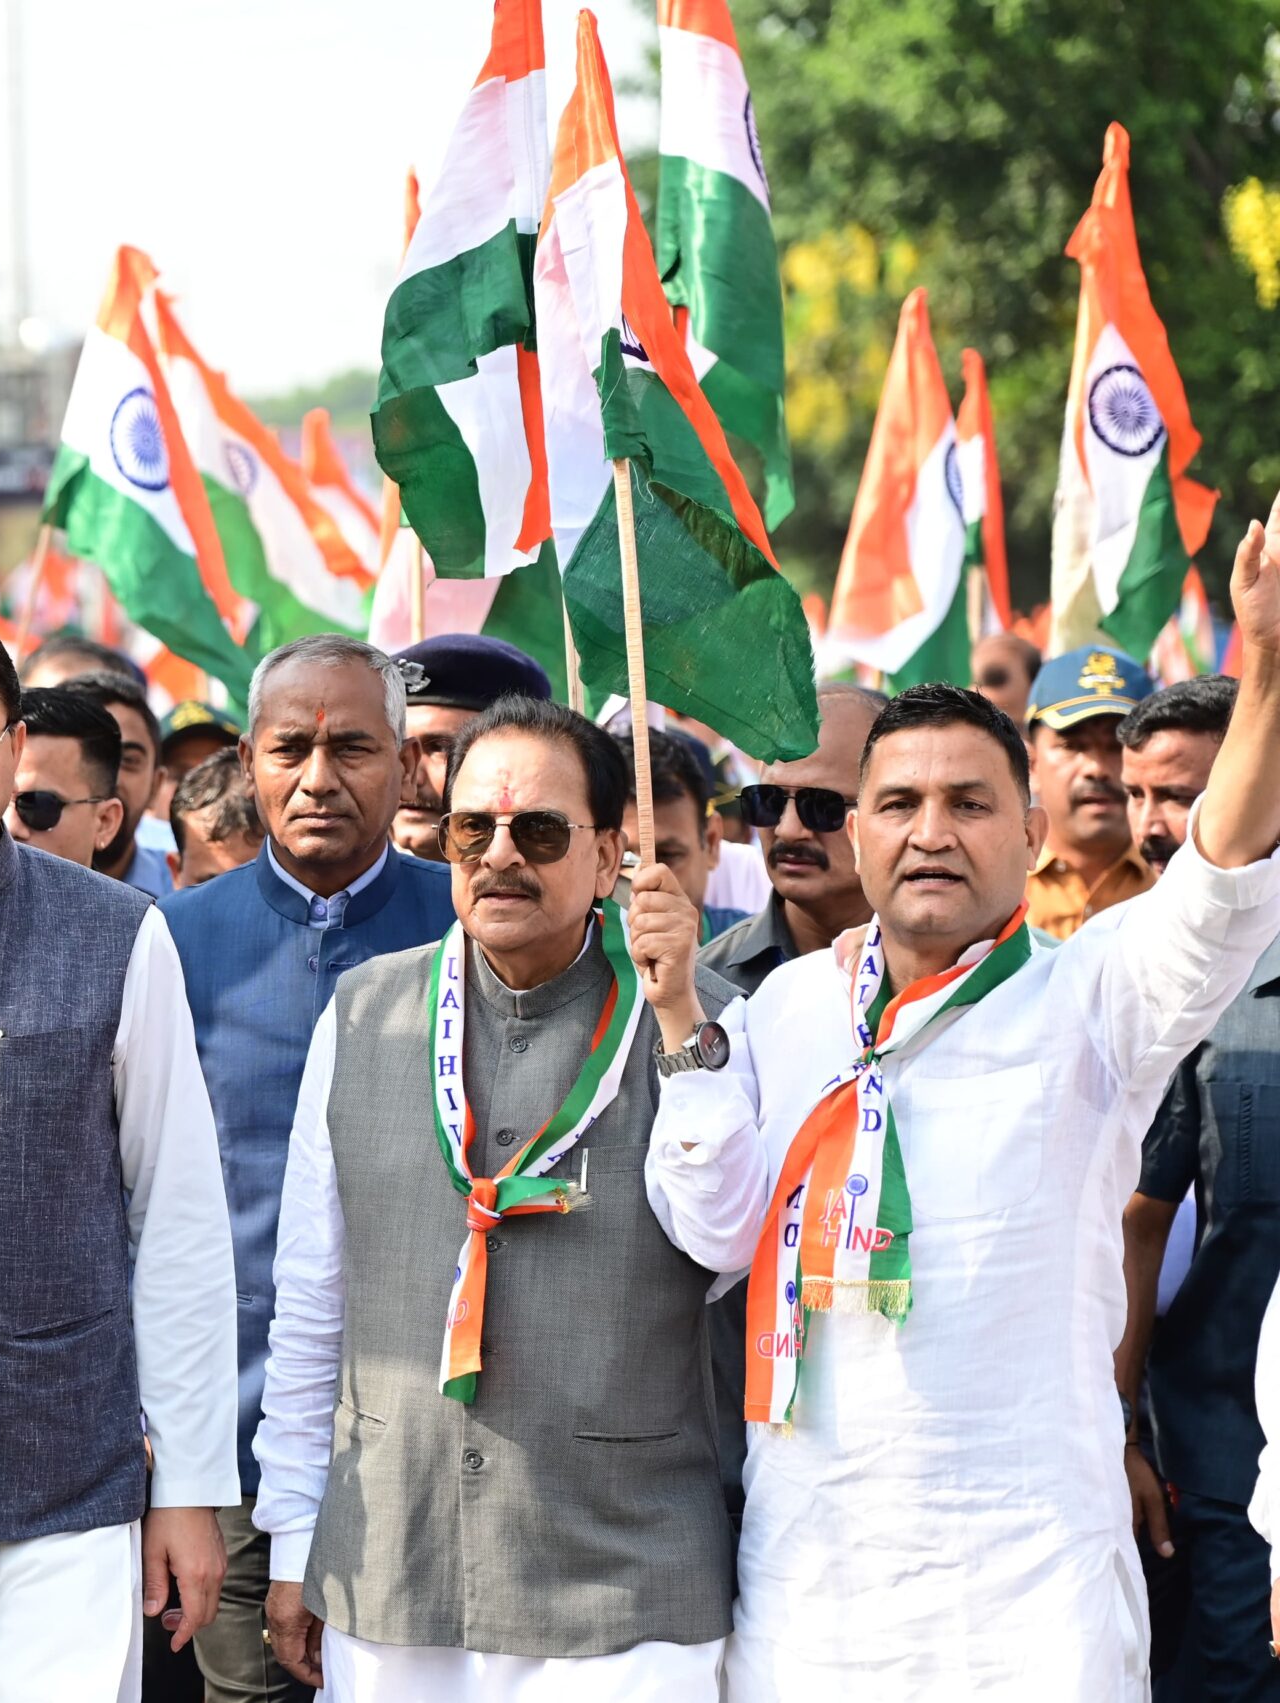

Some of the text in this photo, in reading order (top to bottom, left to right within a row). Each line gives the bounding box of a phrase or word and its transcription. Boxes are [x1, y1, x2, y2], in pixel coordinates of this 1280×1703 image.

[440, 956, 461, 1040] JAI
[858, 924, 883, 1006] JAI
[821, 1221, 895, 1253] HIND
